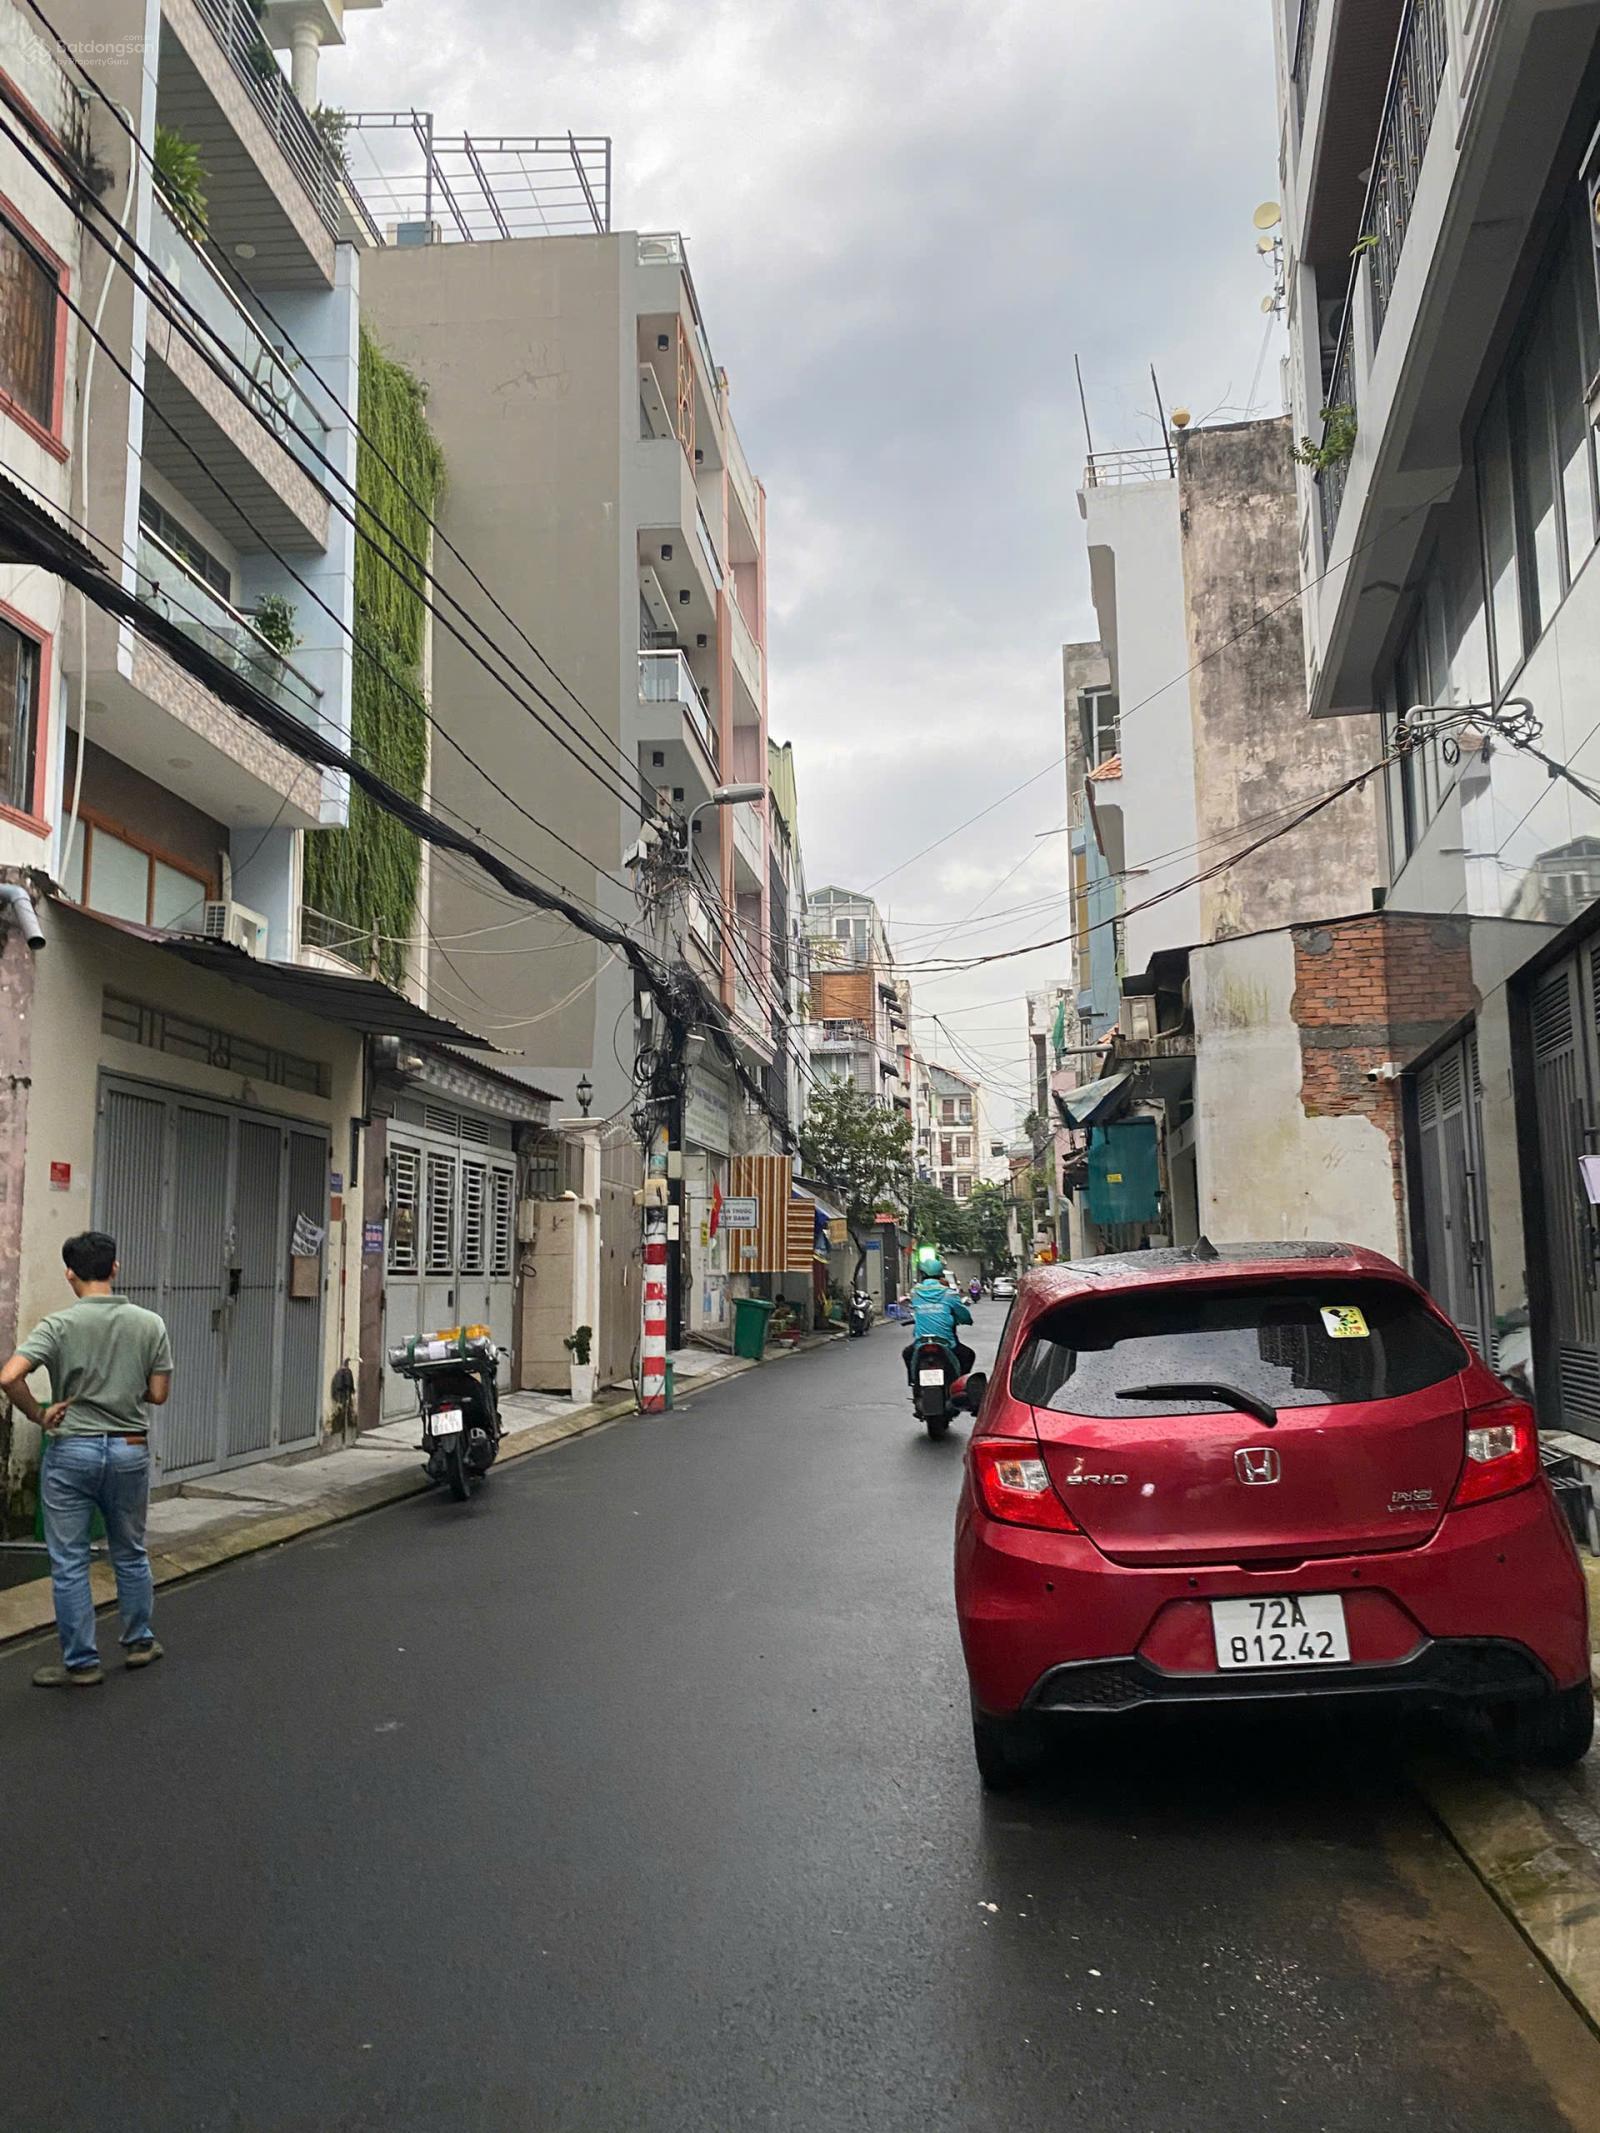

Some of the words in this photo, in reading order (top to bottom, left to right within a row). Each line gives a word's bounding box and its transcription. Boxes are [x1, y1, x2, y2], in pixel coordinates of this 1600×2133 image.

[1066, 1473, 1129, 1486] BRIO
[1249, 1600, 1307, 1629] 72A
[1231, 1631, 1335, 1663] 812.42
